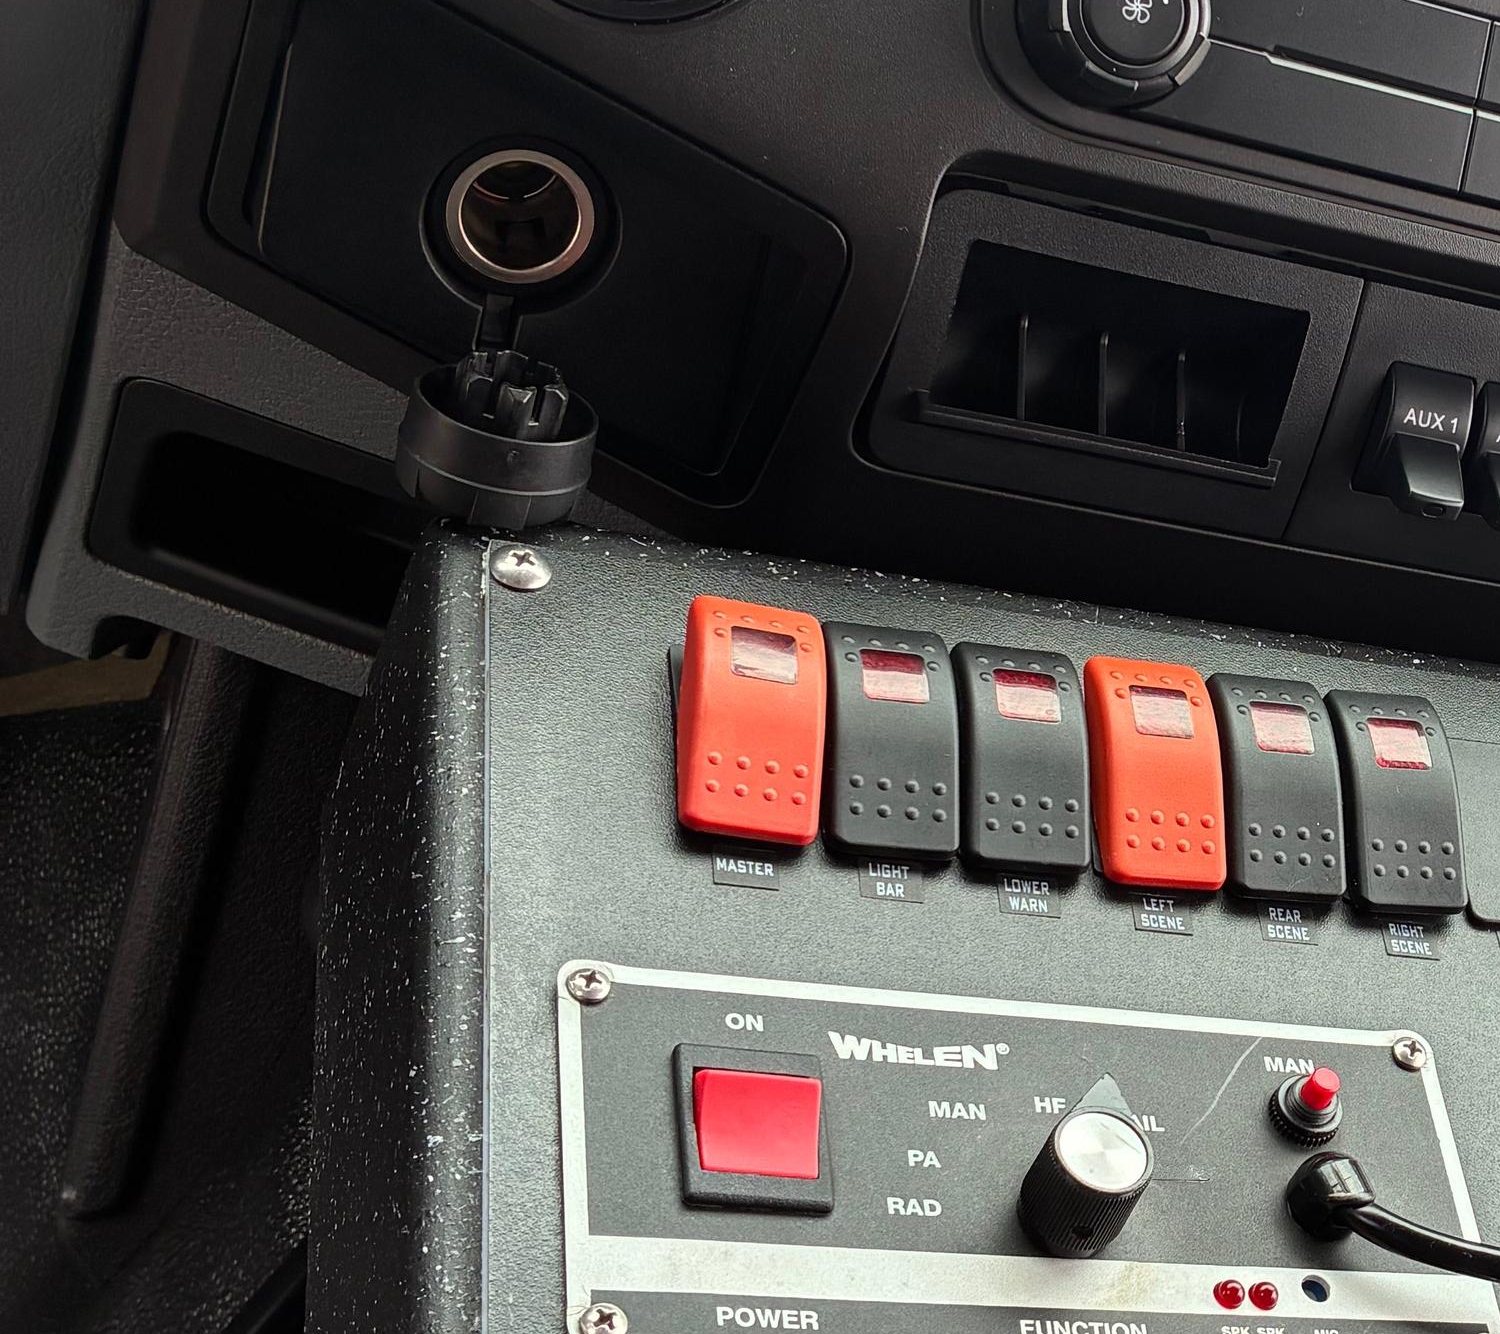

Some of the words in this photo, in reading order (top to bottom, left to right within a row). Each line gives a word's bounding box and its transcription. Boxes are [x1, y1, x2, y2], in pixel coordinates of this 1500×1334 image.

[1403, 407, 1445, 433] AUX
[1449, 417, 1459, 434] 1
[715, 857, 775, 876] MASTER
[868, 862, 910, 879] LIGHT
[876, 882, 905, 897] BAR
[1003, 878, 1050, 895] LOWER
[1008, 896, 1048, 913] WARN
[1142, 898, 1174, 913] LEFT
[1141, 913, 1186, 930] SCENE
[1268, 907, 1302, 923] REAR
[1267, 924, 1310, 941] SCENE
[1388, 923, 1425, 939] RIGHT
[1390, 939, 1433, 955] SCENE
[725, 1012, 764, 1032] ON
[1263, 1056, 1317, 1075] MAN
[928, 1100, 987, 1121] MAN
[1033, 1096, 1066, 1114] HF
[907, 1149, 942, 1168] PA
[886, 1196, 943, 1217] RAD
[715, 1306, 820, 1331] POWER
